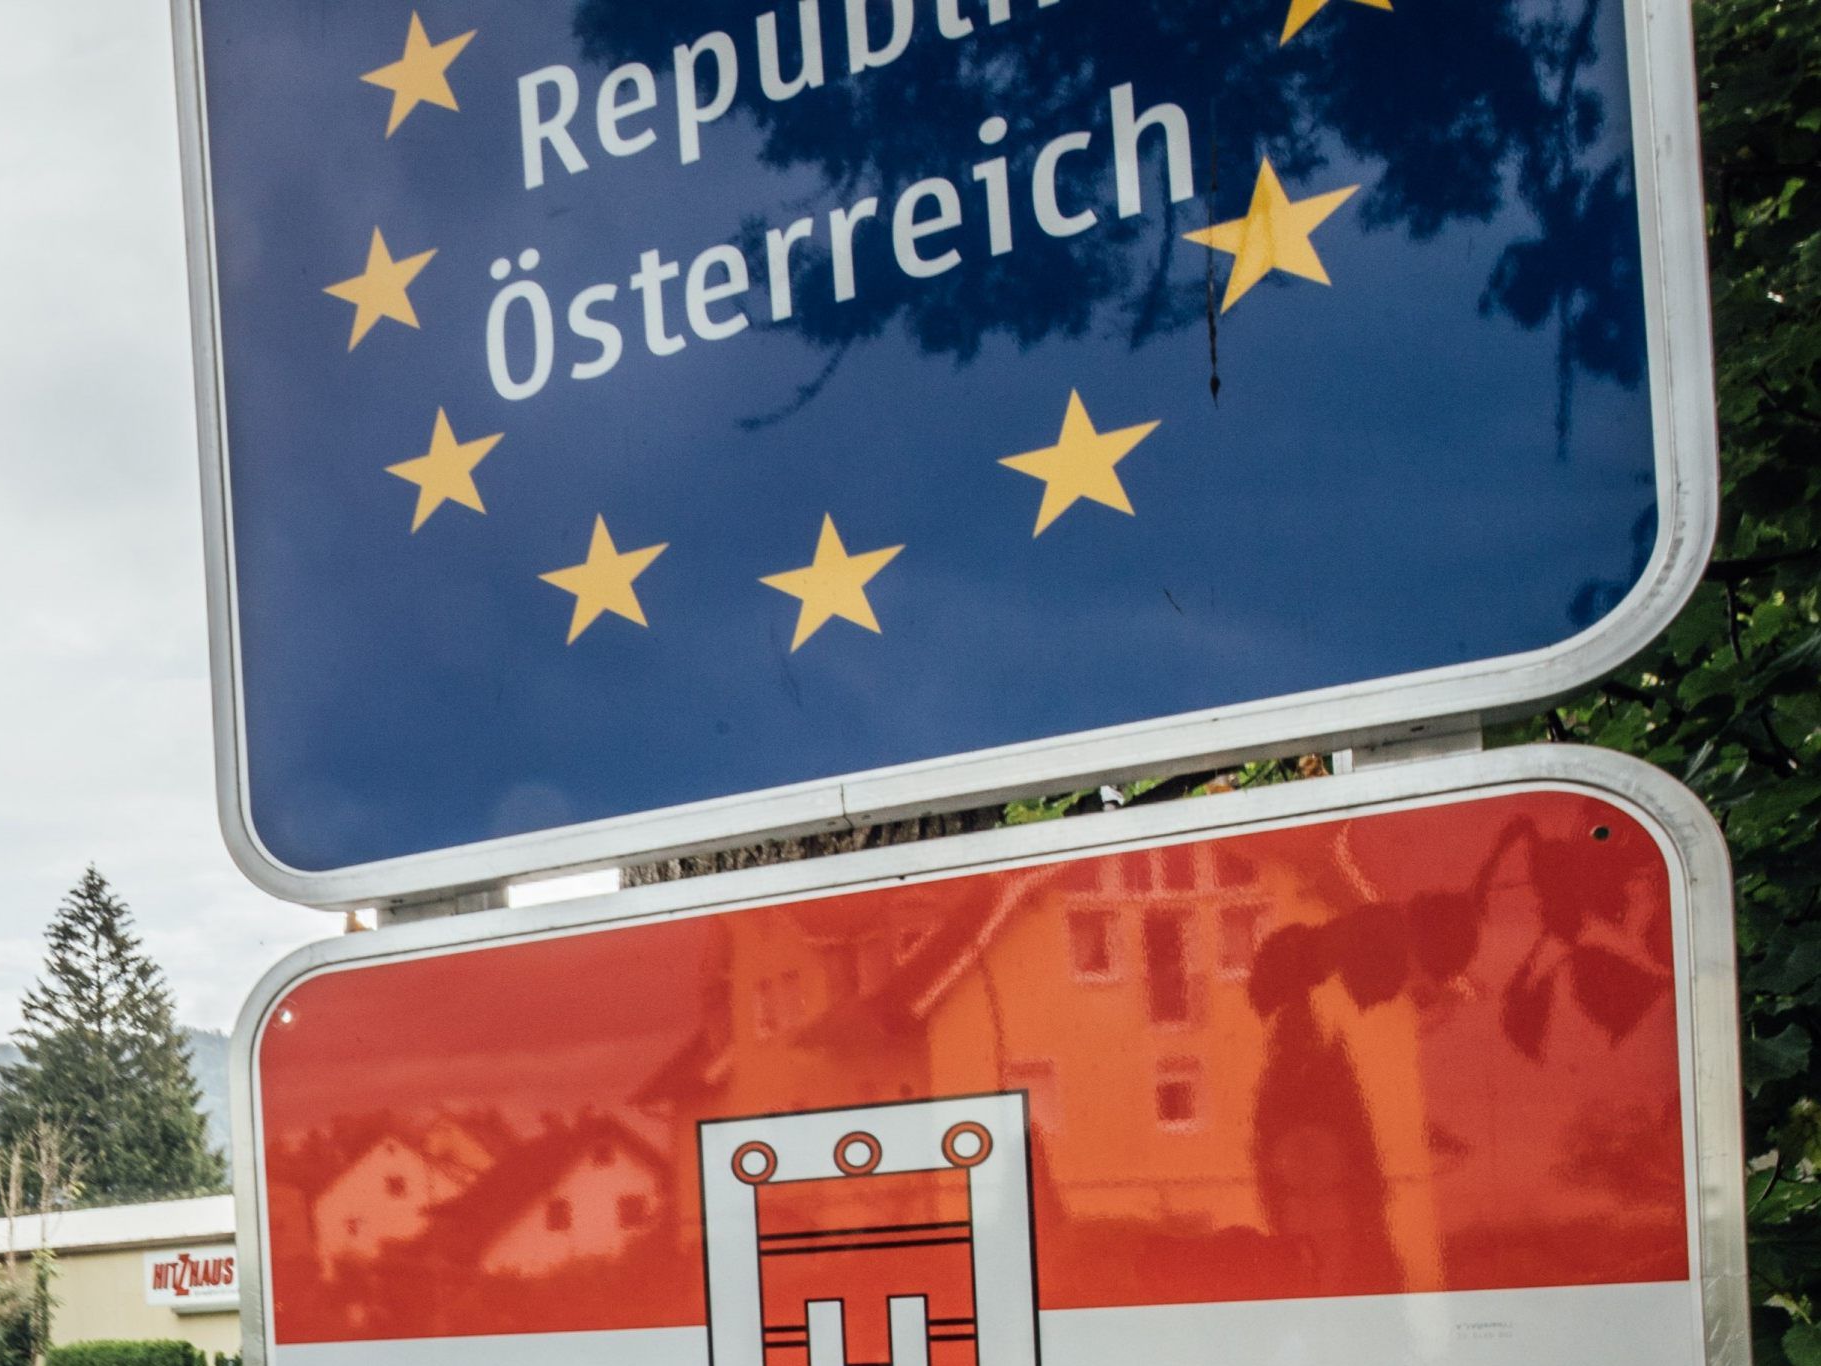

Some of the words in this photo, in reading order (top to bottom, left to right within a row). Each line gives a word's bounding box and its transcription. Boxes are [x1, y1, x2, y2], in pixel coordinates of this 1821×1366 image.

[517, 0, 1061, 190] Repub
[486, 82, 1194, 402] Österreich
[153, 1253, 234, 1296] HITZHAUS
